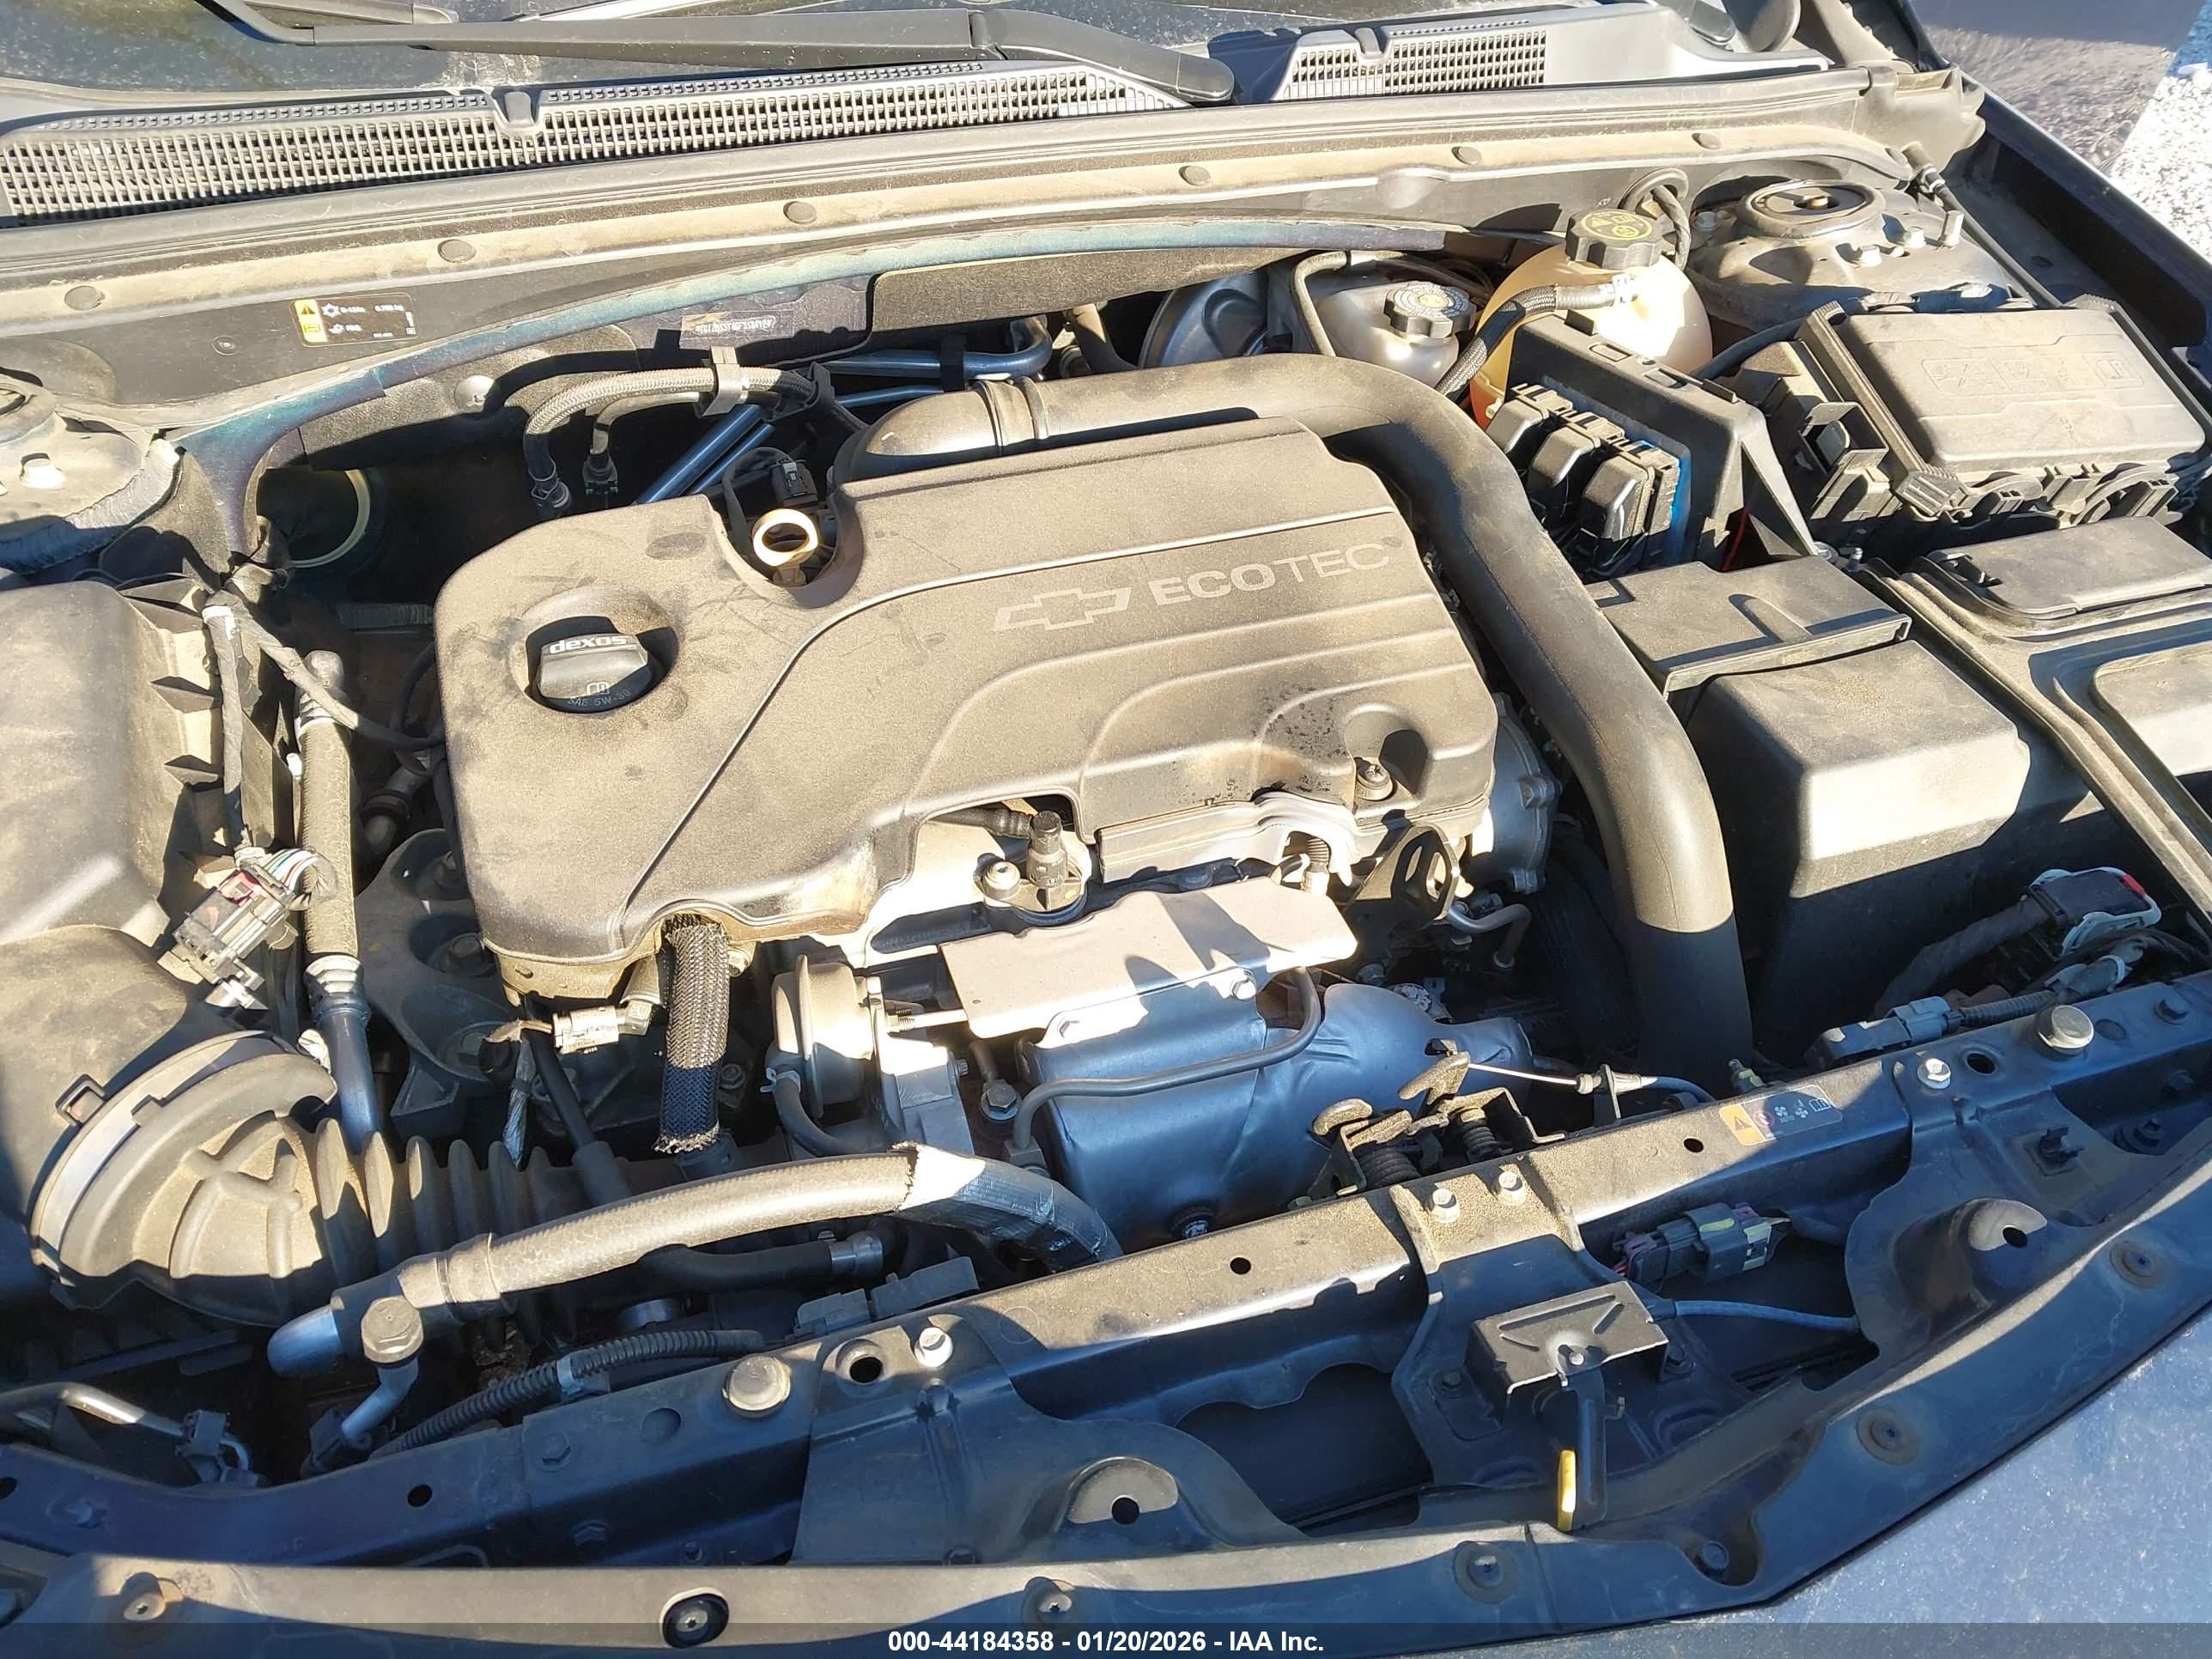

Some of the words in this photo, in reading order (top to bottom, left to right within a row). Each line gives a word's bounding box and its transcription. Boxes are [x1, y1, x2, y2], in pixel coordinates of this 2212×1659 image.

[1148, 543, 1390, 606] ECOTEC
[550, 635, 627, 653] dexos
[568, 696, 589, 707] SAE
